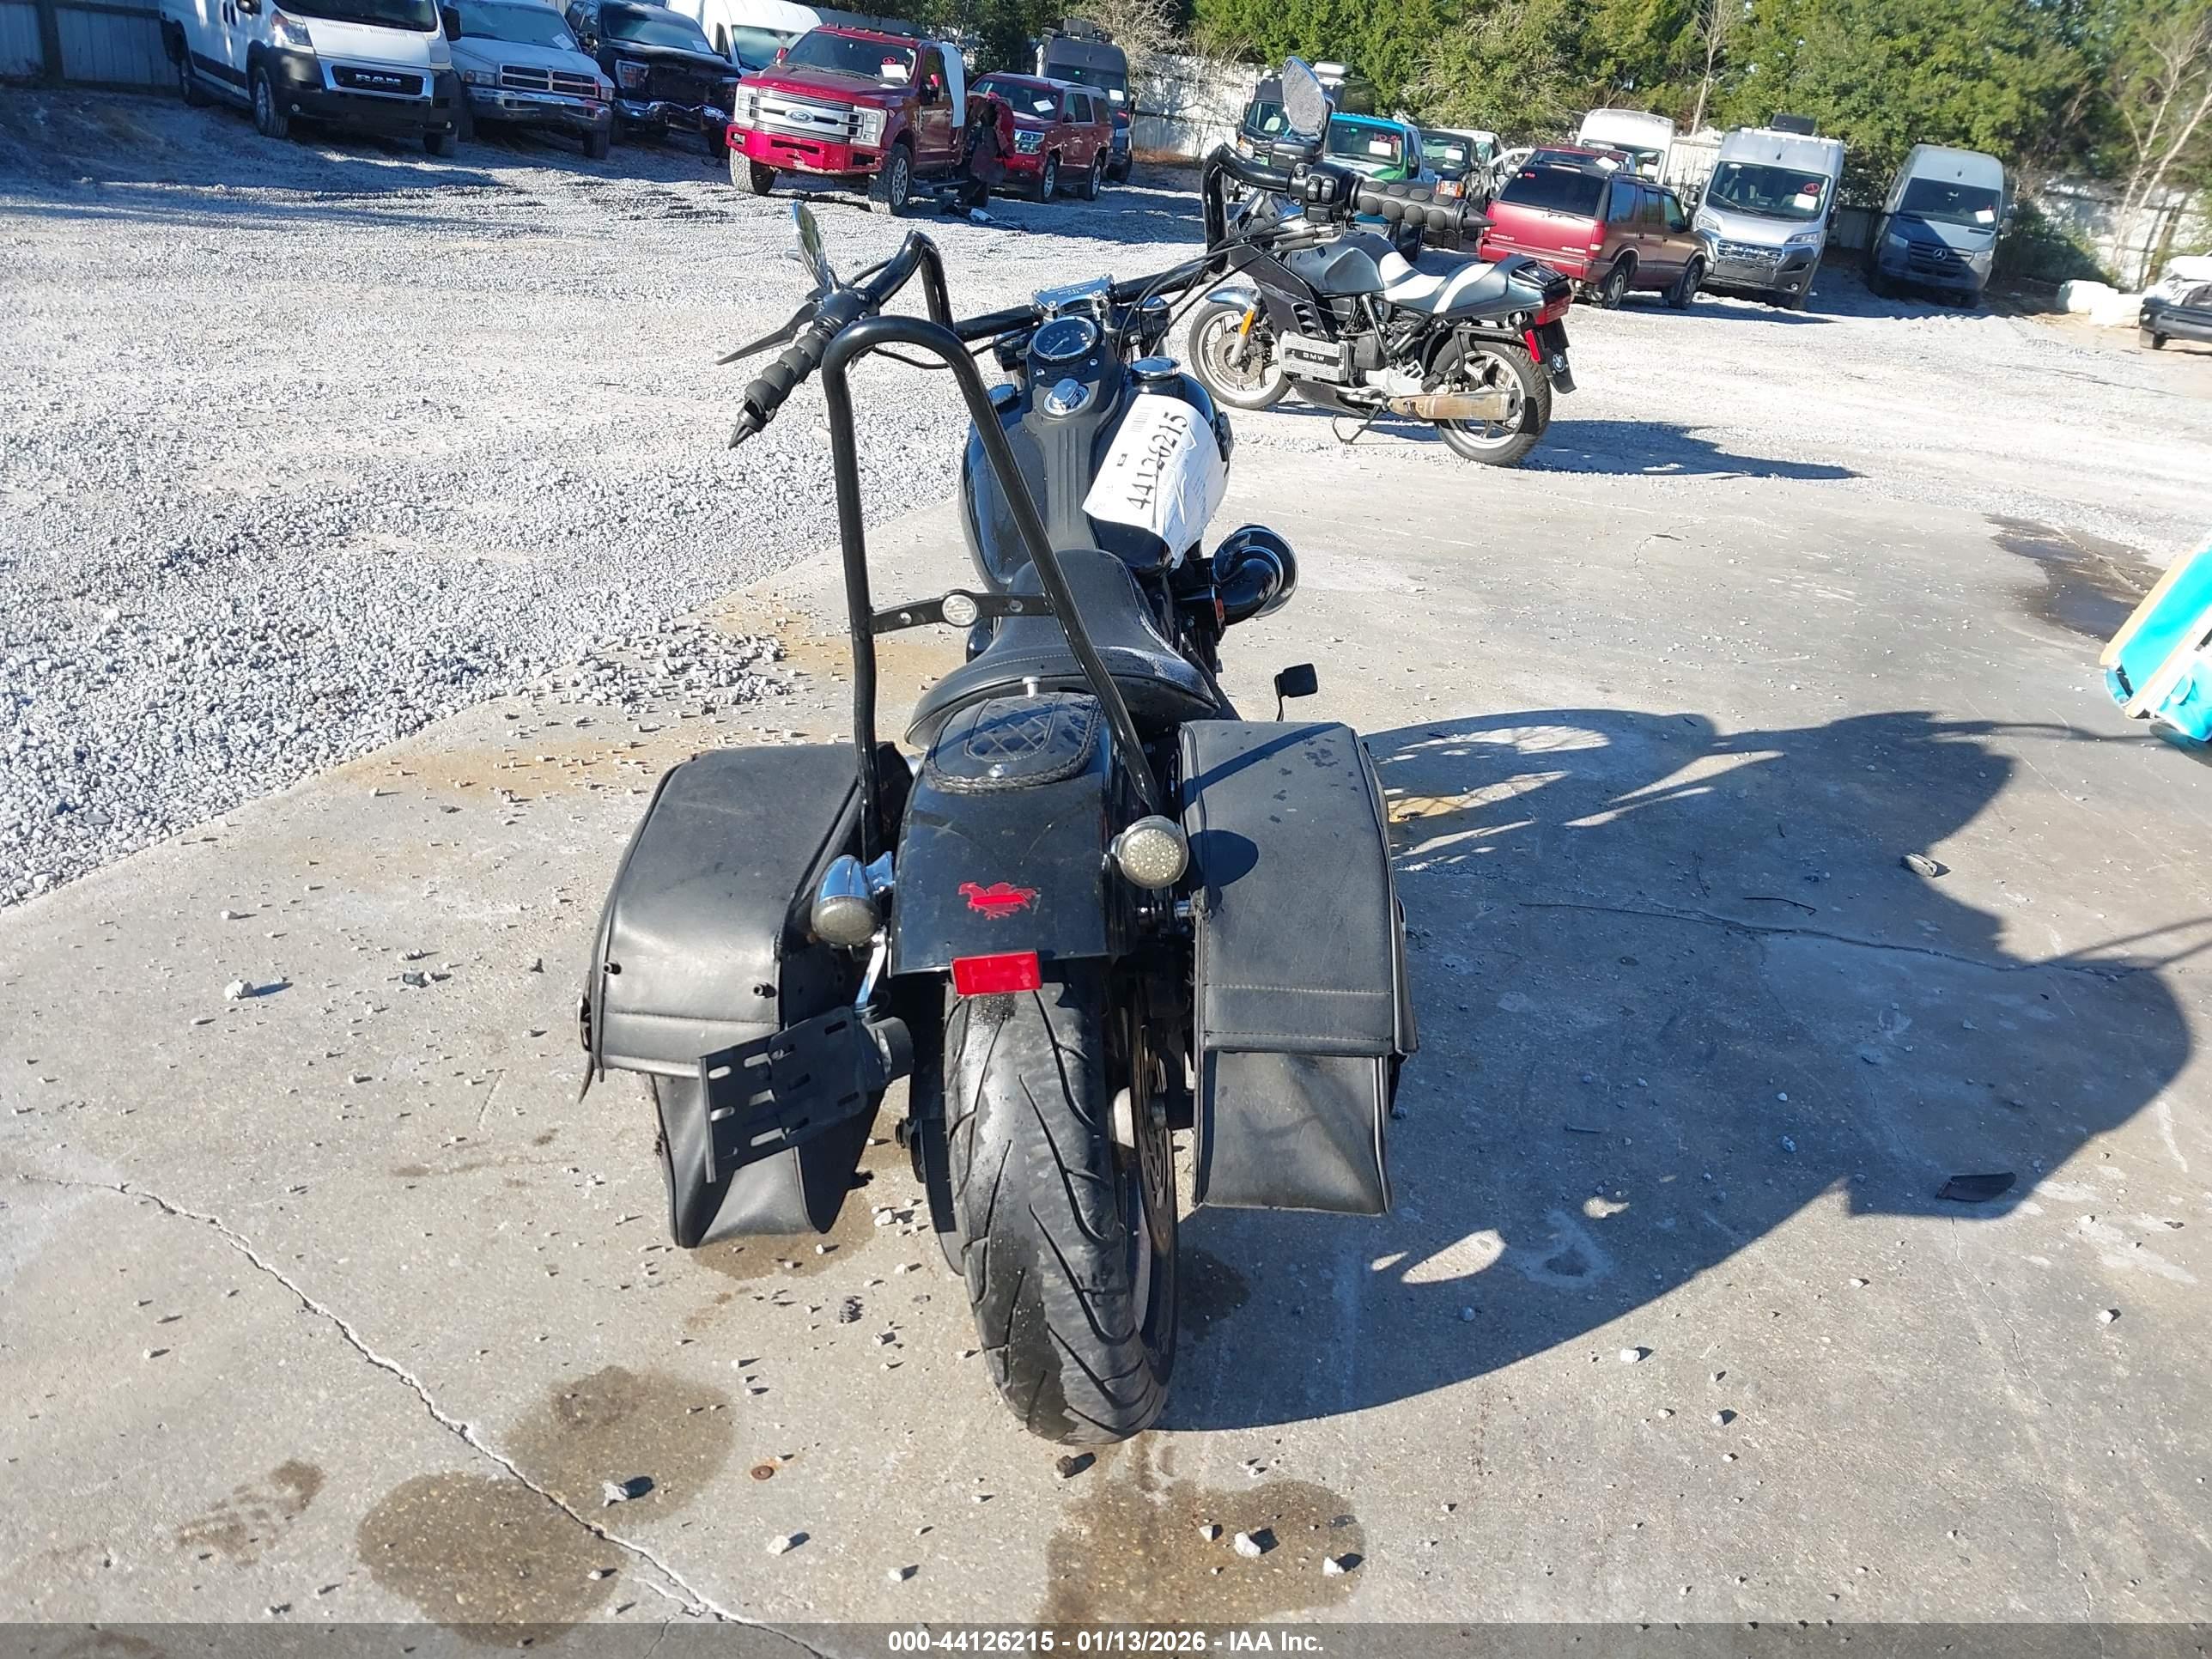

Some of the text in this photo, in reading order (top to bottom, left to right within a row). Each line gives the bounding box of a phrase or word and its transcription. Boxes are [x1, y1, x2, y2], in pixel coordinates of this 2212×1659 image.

[356, 74, 402, 85] RAM
[1303, 351, 1325, 362] BMW
[1127, 411, 1188, 510] 44126215
